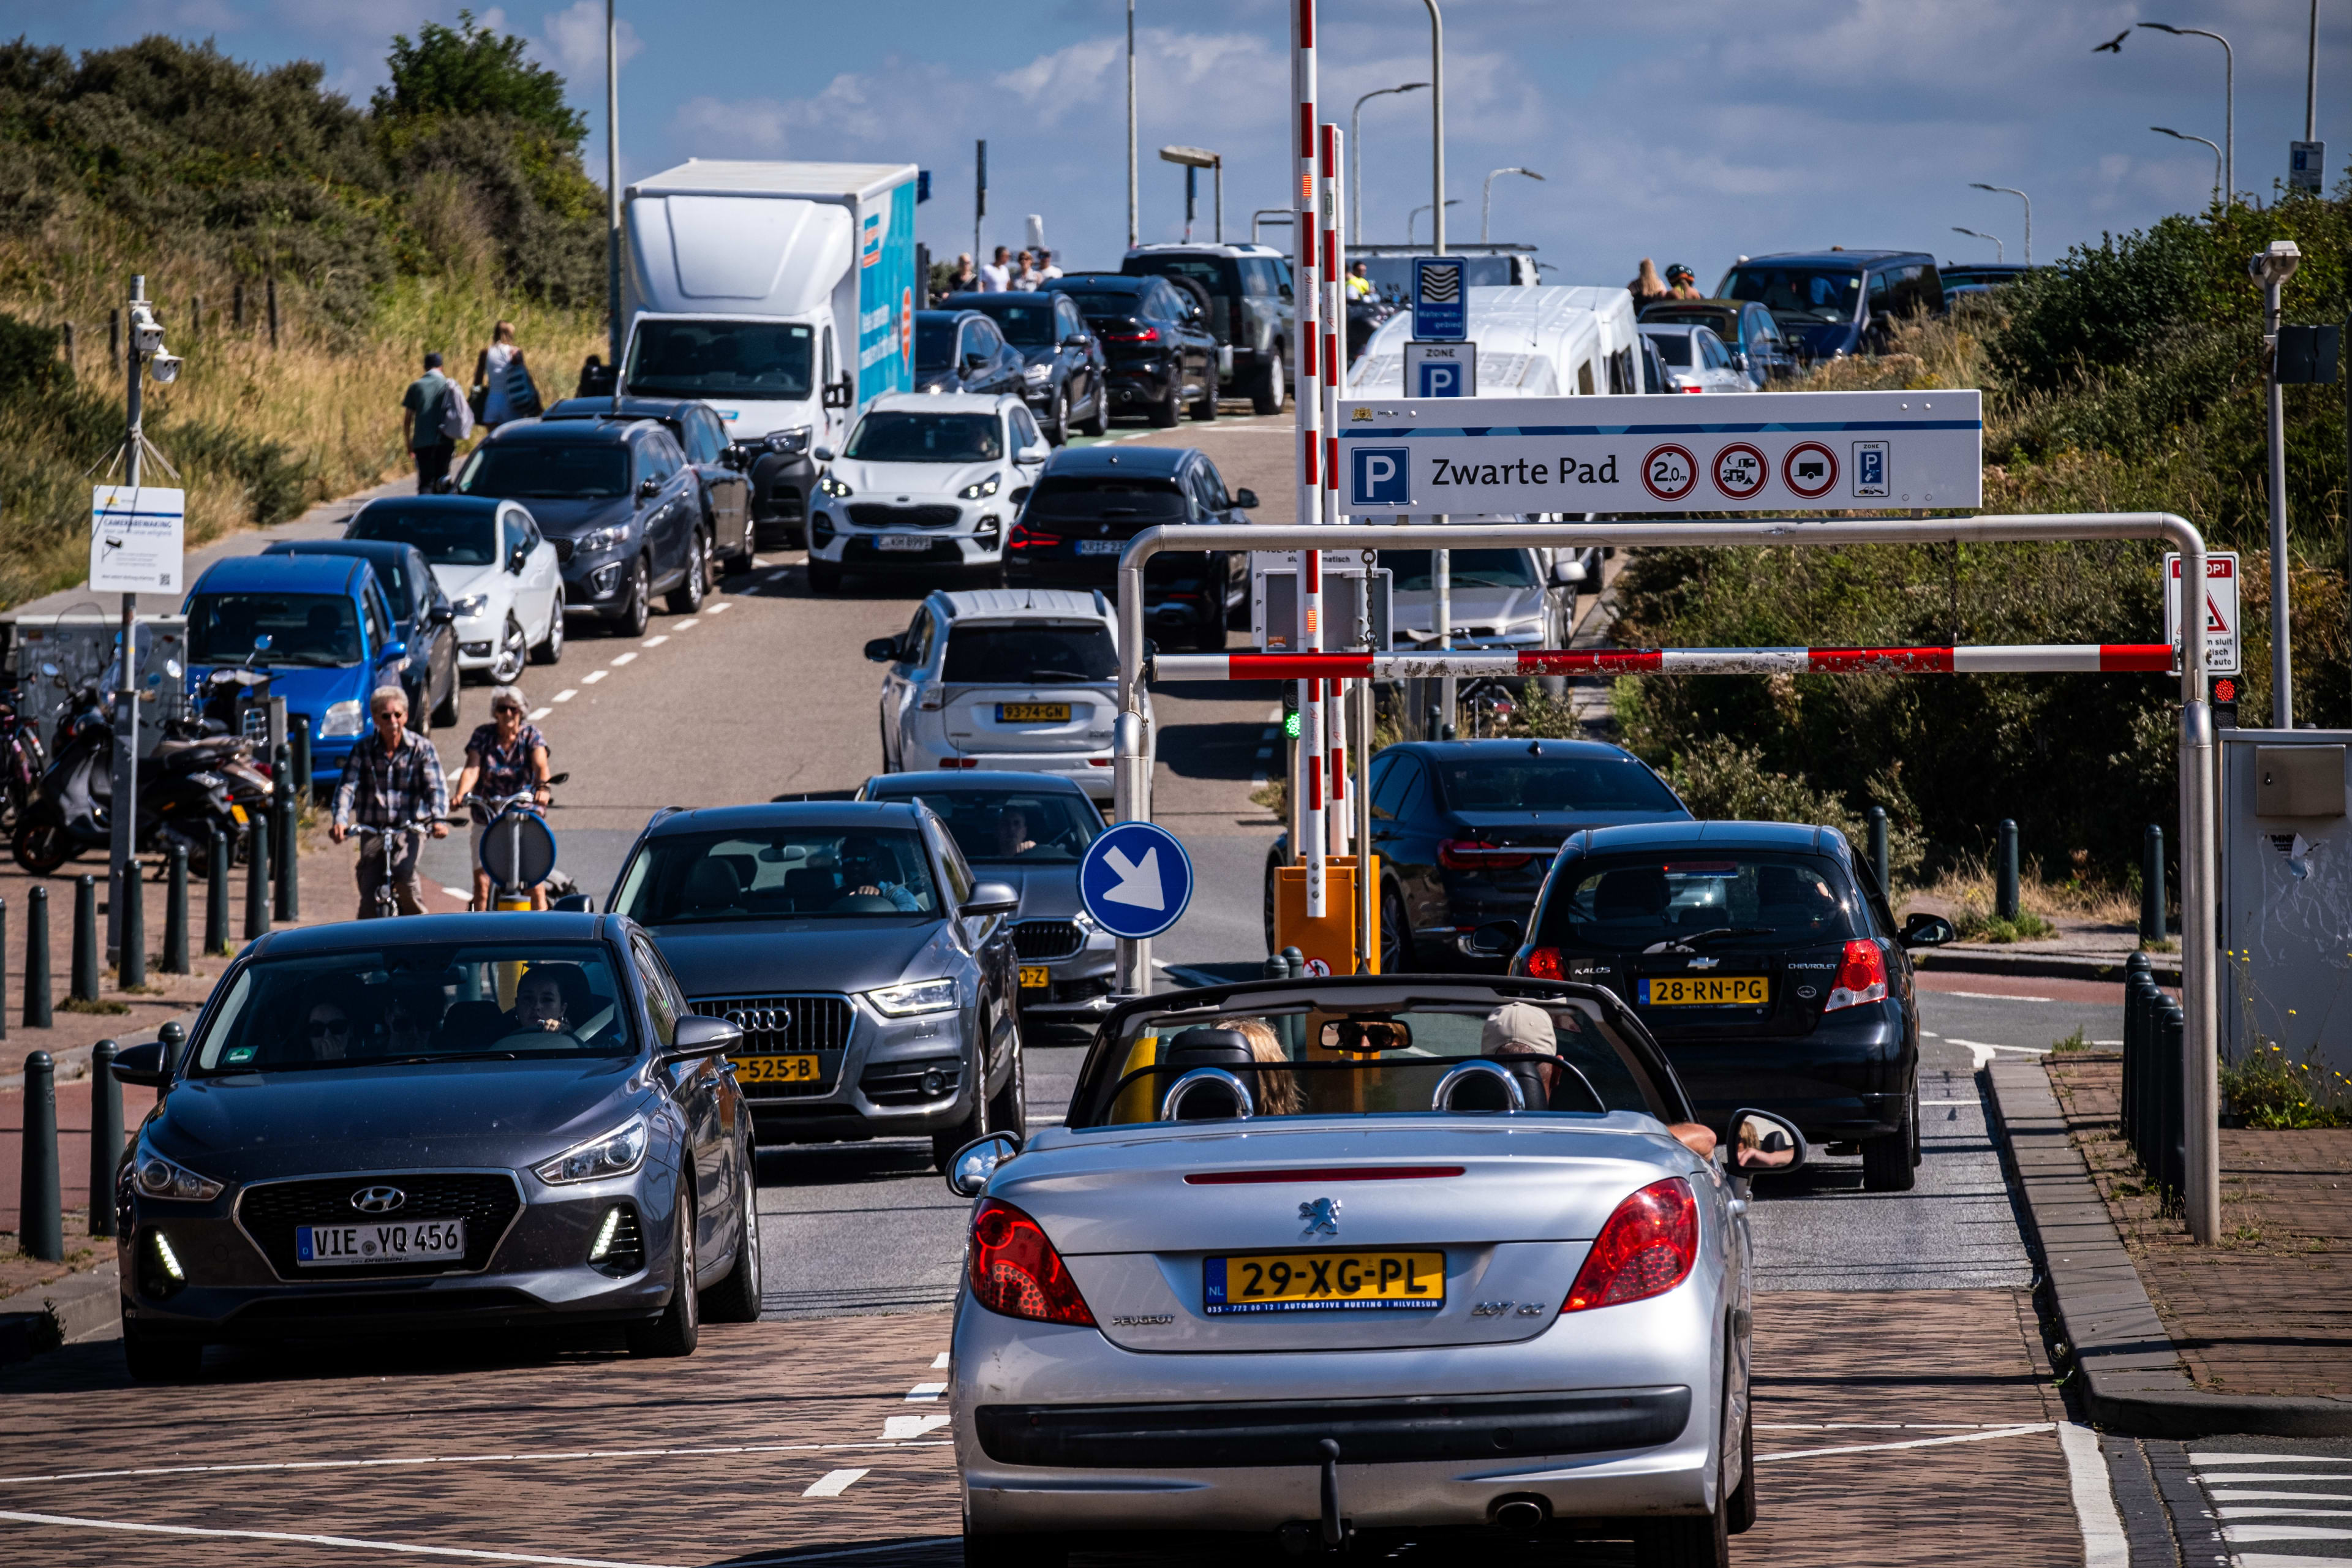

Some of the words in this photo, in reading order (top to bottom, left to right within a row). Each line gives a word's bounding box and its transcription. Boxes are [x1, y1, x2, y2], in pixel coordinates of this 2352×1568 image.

[1430, 369, 1452, 397] P
[1431, 457, 1548, 486] Zwarte
[1559, 454, 1619, 484] Pad
[1866, 454, 1877, 470] P
[1366, 456, 1396, 497] P
[1574, 967, 1611, 975] KALOS
[1656, 980, 1762, 1001] 28-RN-PG
[314, 1229, 358, 1256] VIE
[377, 1227, 408, 1253] YQ
[414, 1224, 458, 1251] 456
[1242, 1257, 1427, 1296] 29-XG-PL
[1209, 1286, 1224, 1297] NL
[1472, 1302, 1515, 1315] 207
[1518, 1303, 1547, 1315] CC
[1112, 1314, 1175, 1325] PEUGEOT
